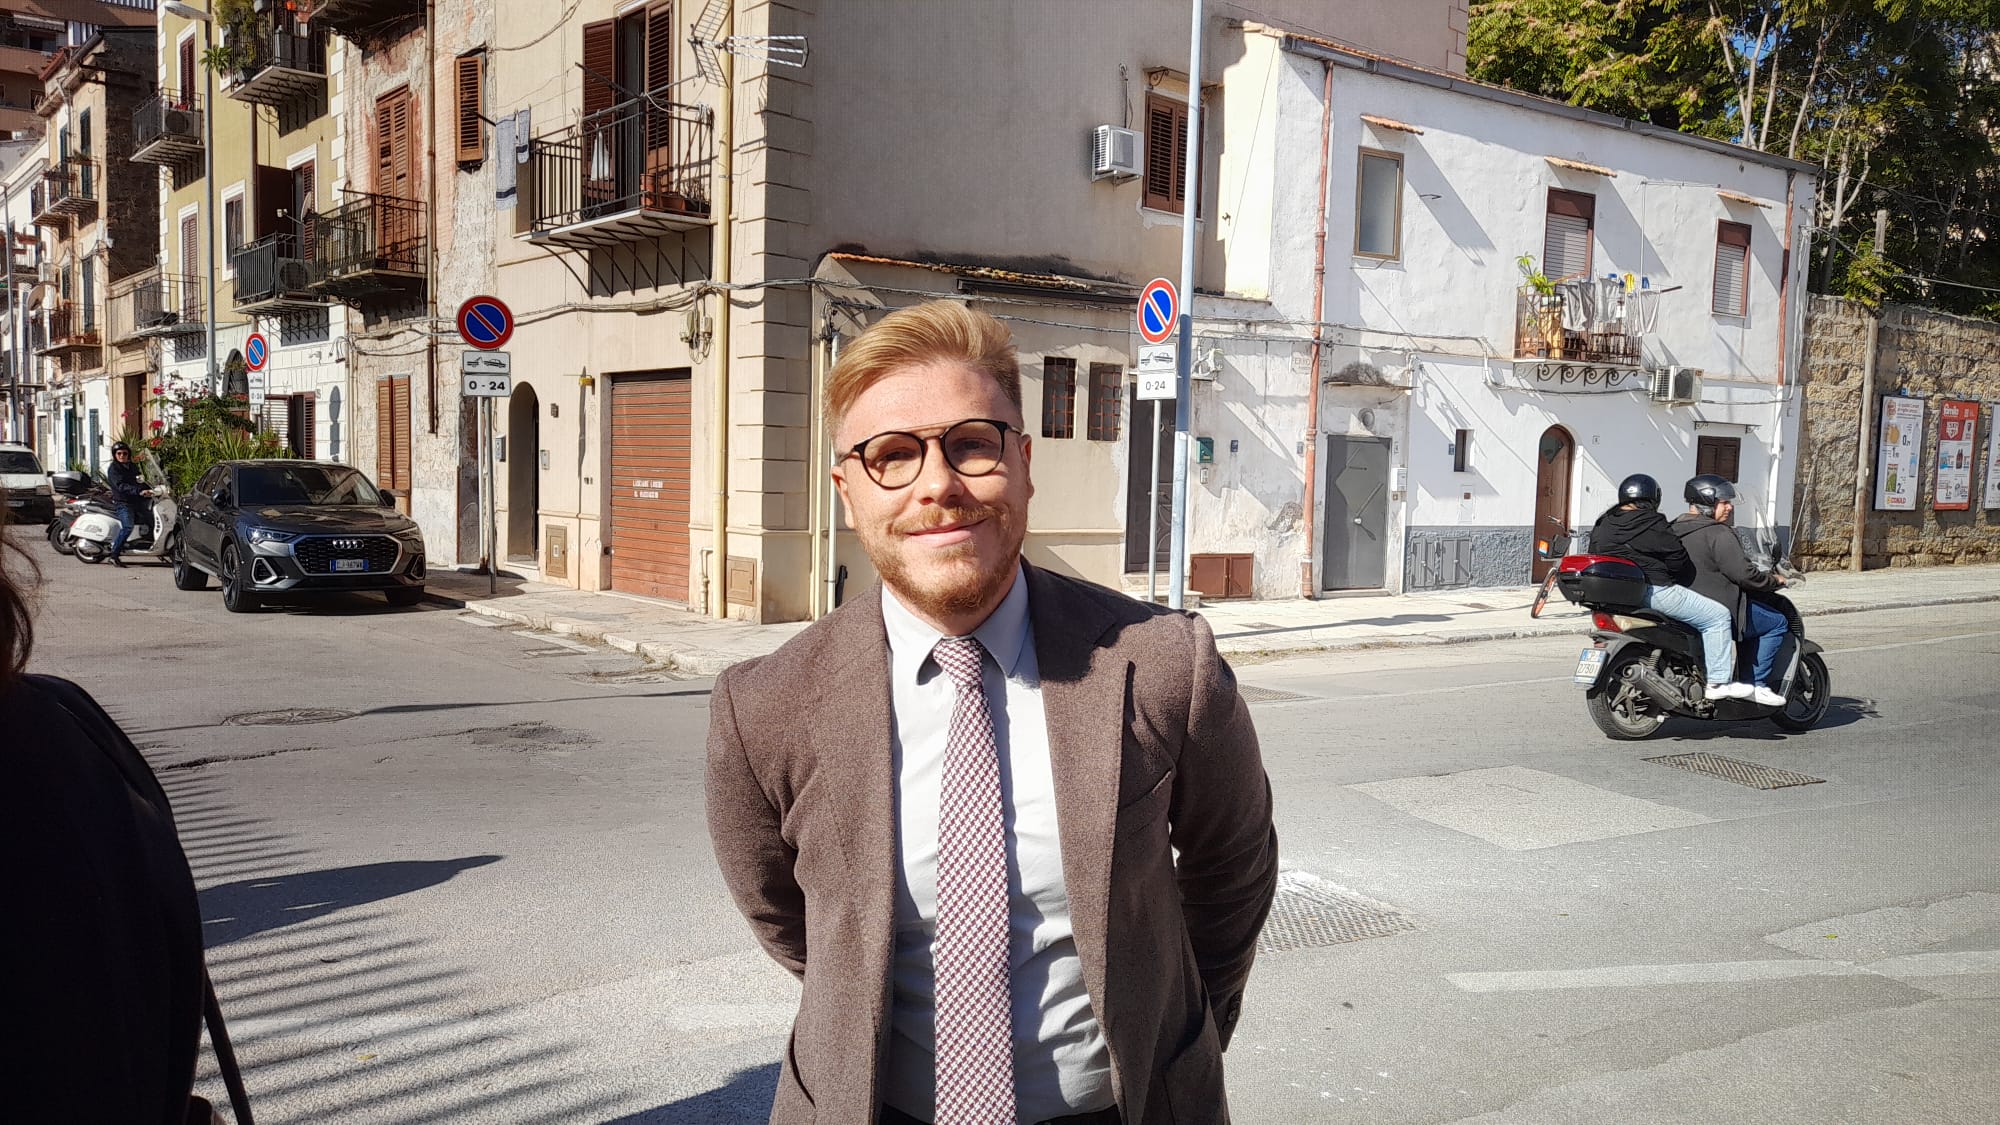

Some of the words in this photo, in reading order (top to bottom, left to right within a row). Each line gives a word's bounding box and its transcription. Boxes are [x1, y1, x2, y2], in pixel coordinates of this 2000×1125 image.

[468, 380, 478, 390] 0
[489, 381, 505, 391] 24
[1145, 380, 1166, 391] 0-24
